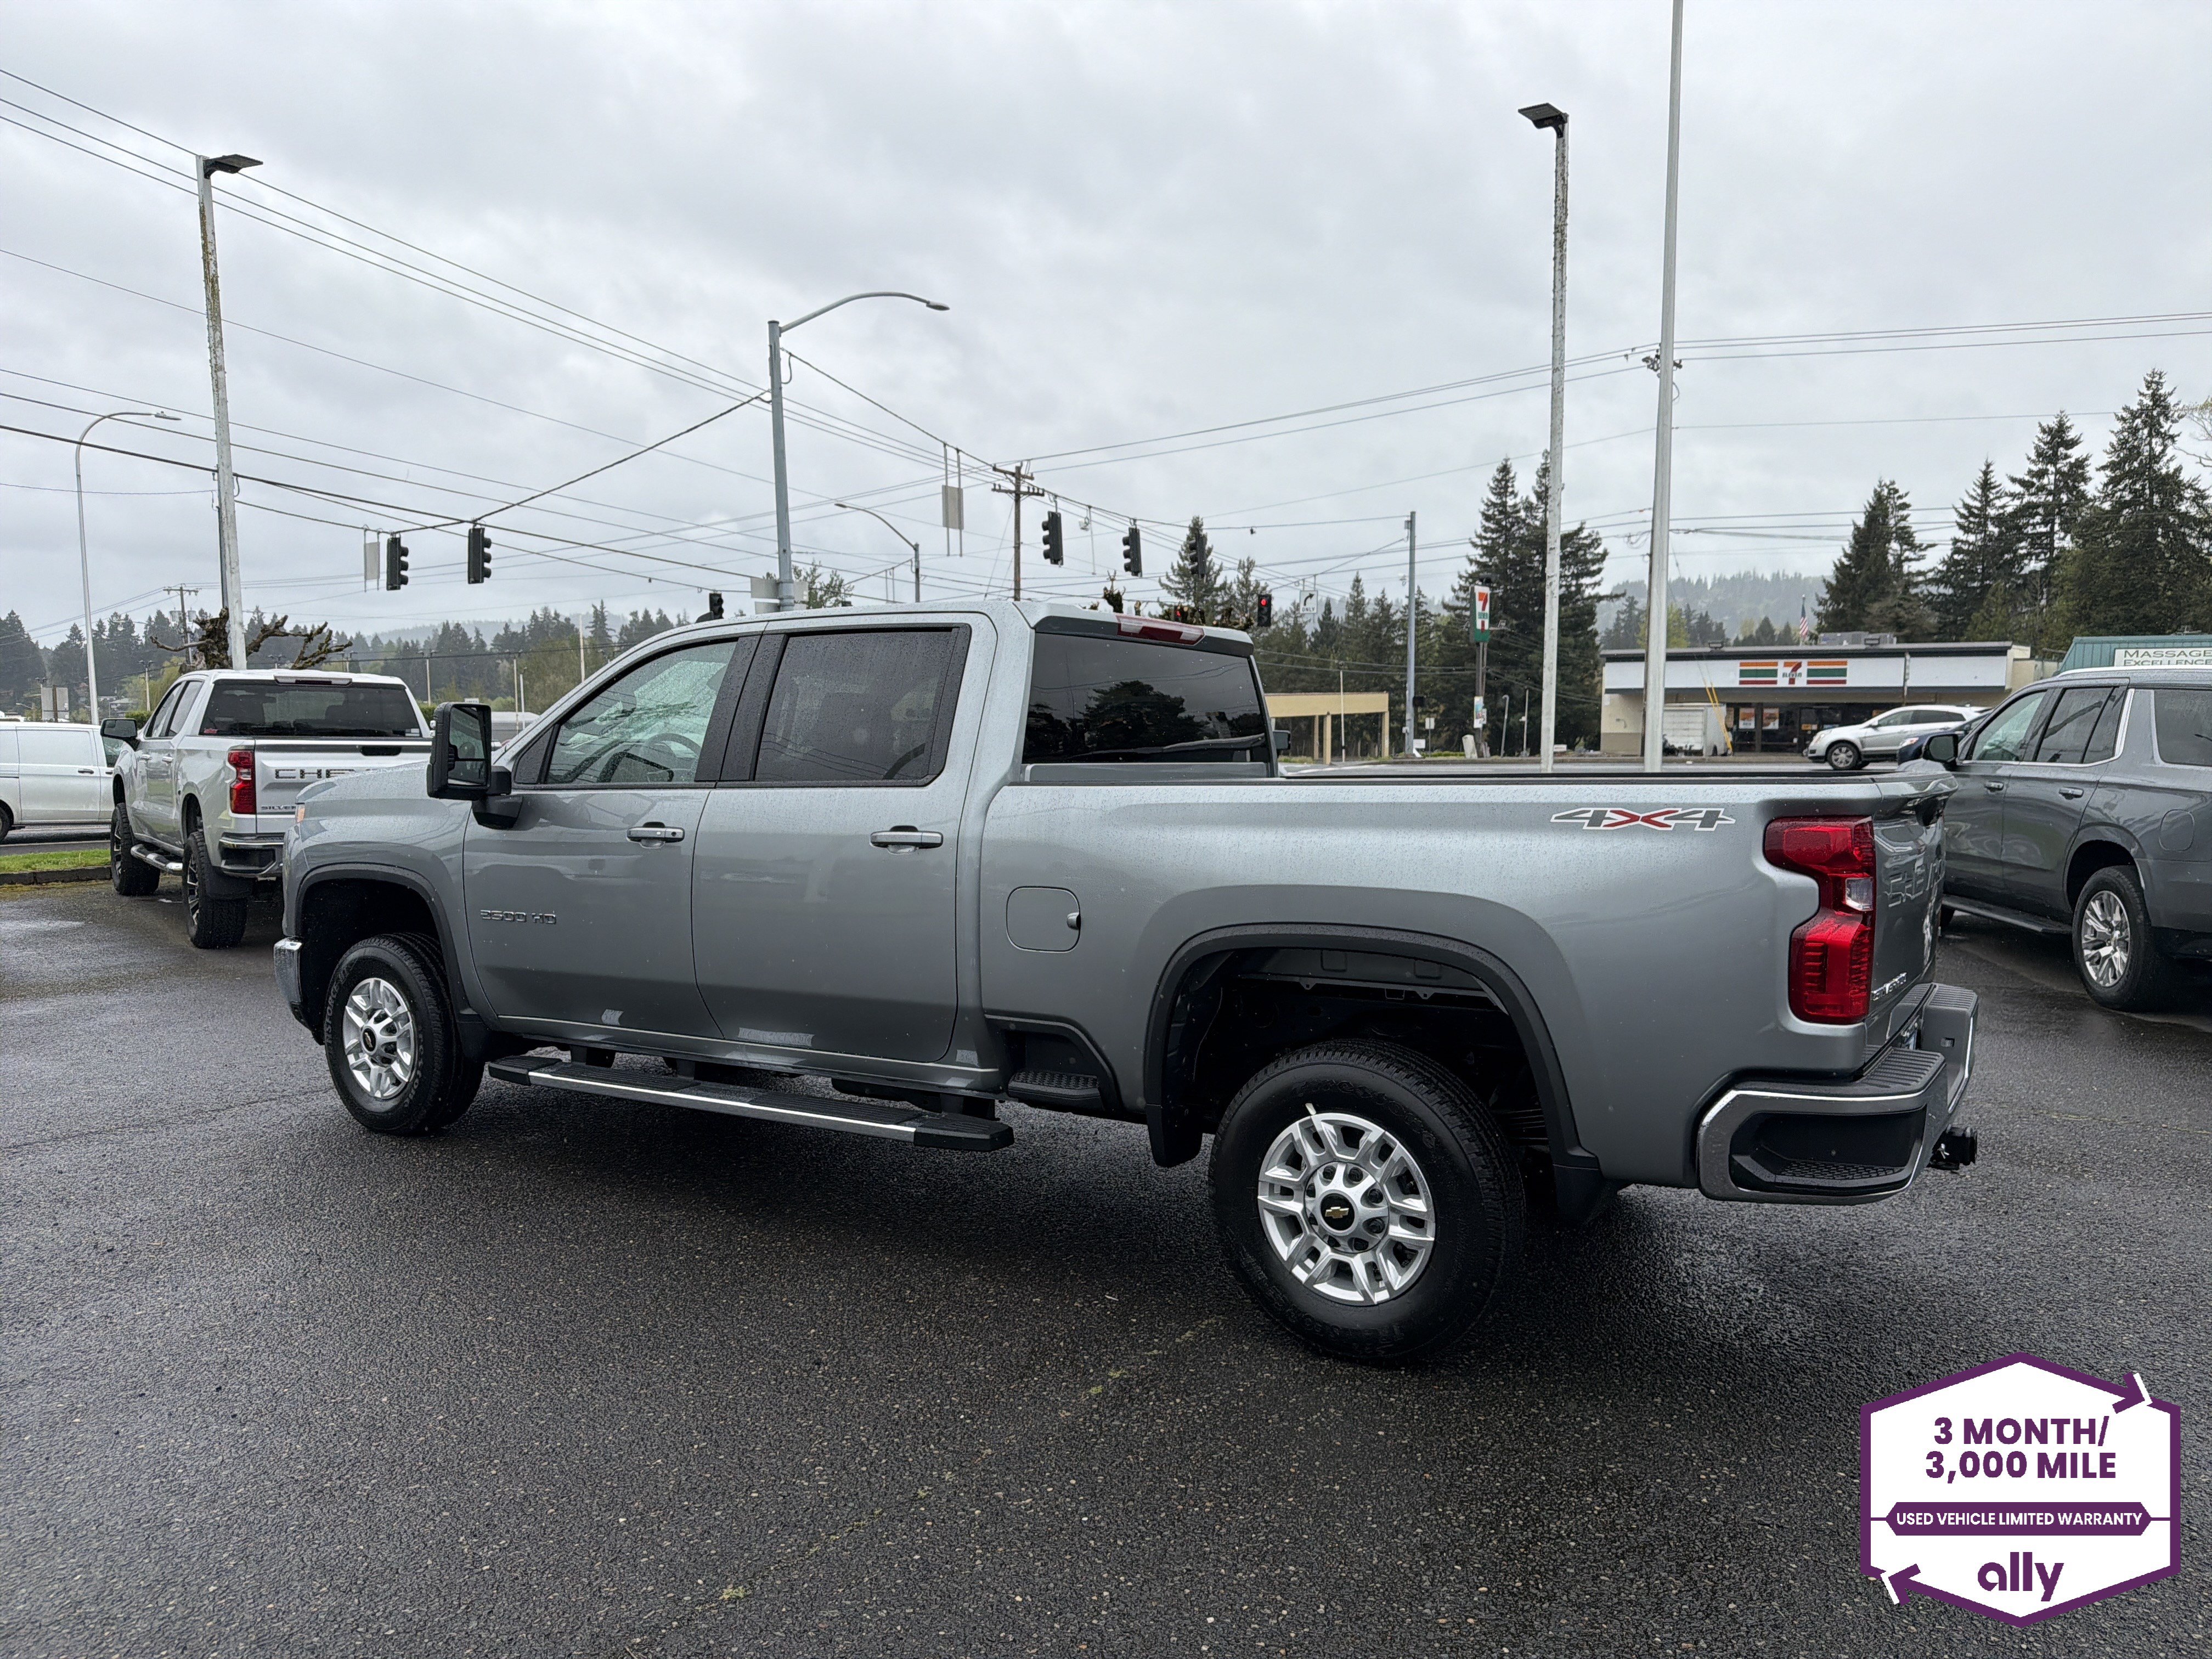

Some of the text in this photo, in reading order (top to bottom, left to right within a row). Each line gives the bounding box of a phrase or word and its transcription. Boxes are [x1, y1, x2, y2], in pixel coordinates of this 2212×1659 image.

[2124, 650, 2212, 658] MASSAGE
[480, 910, 557, 924] 2500 HD
